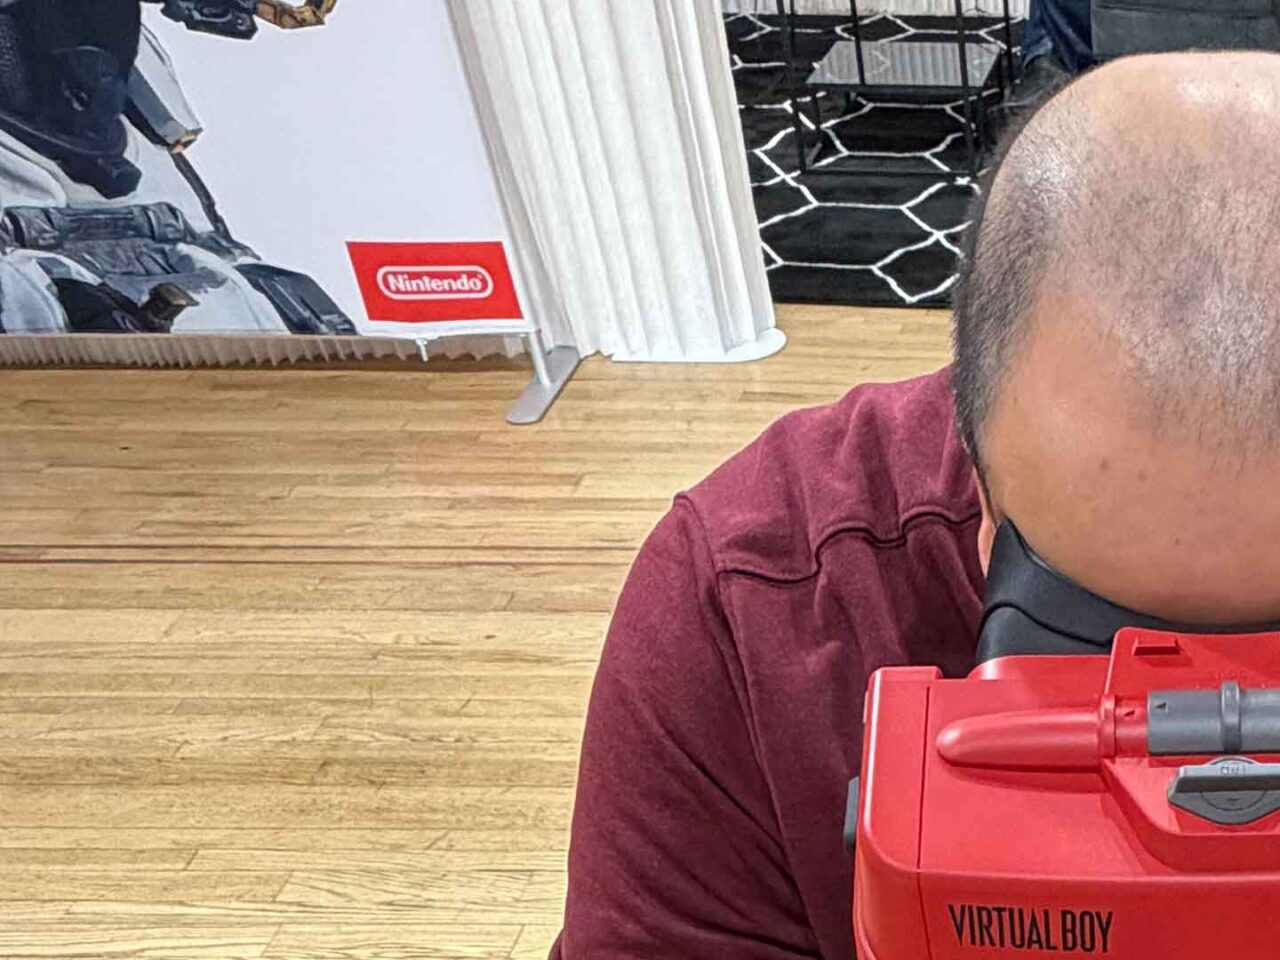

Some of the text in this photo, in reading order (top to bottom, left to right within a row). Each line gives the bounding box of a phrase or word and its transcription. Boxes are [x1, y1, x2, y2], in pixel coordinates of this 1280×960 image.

[386, 274, 482, 292] Nintendo
[947, 903, 1113, 953] VIRTUAL BOY
